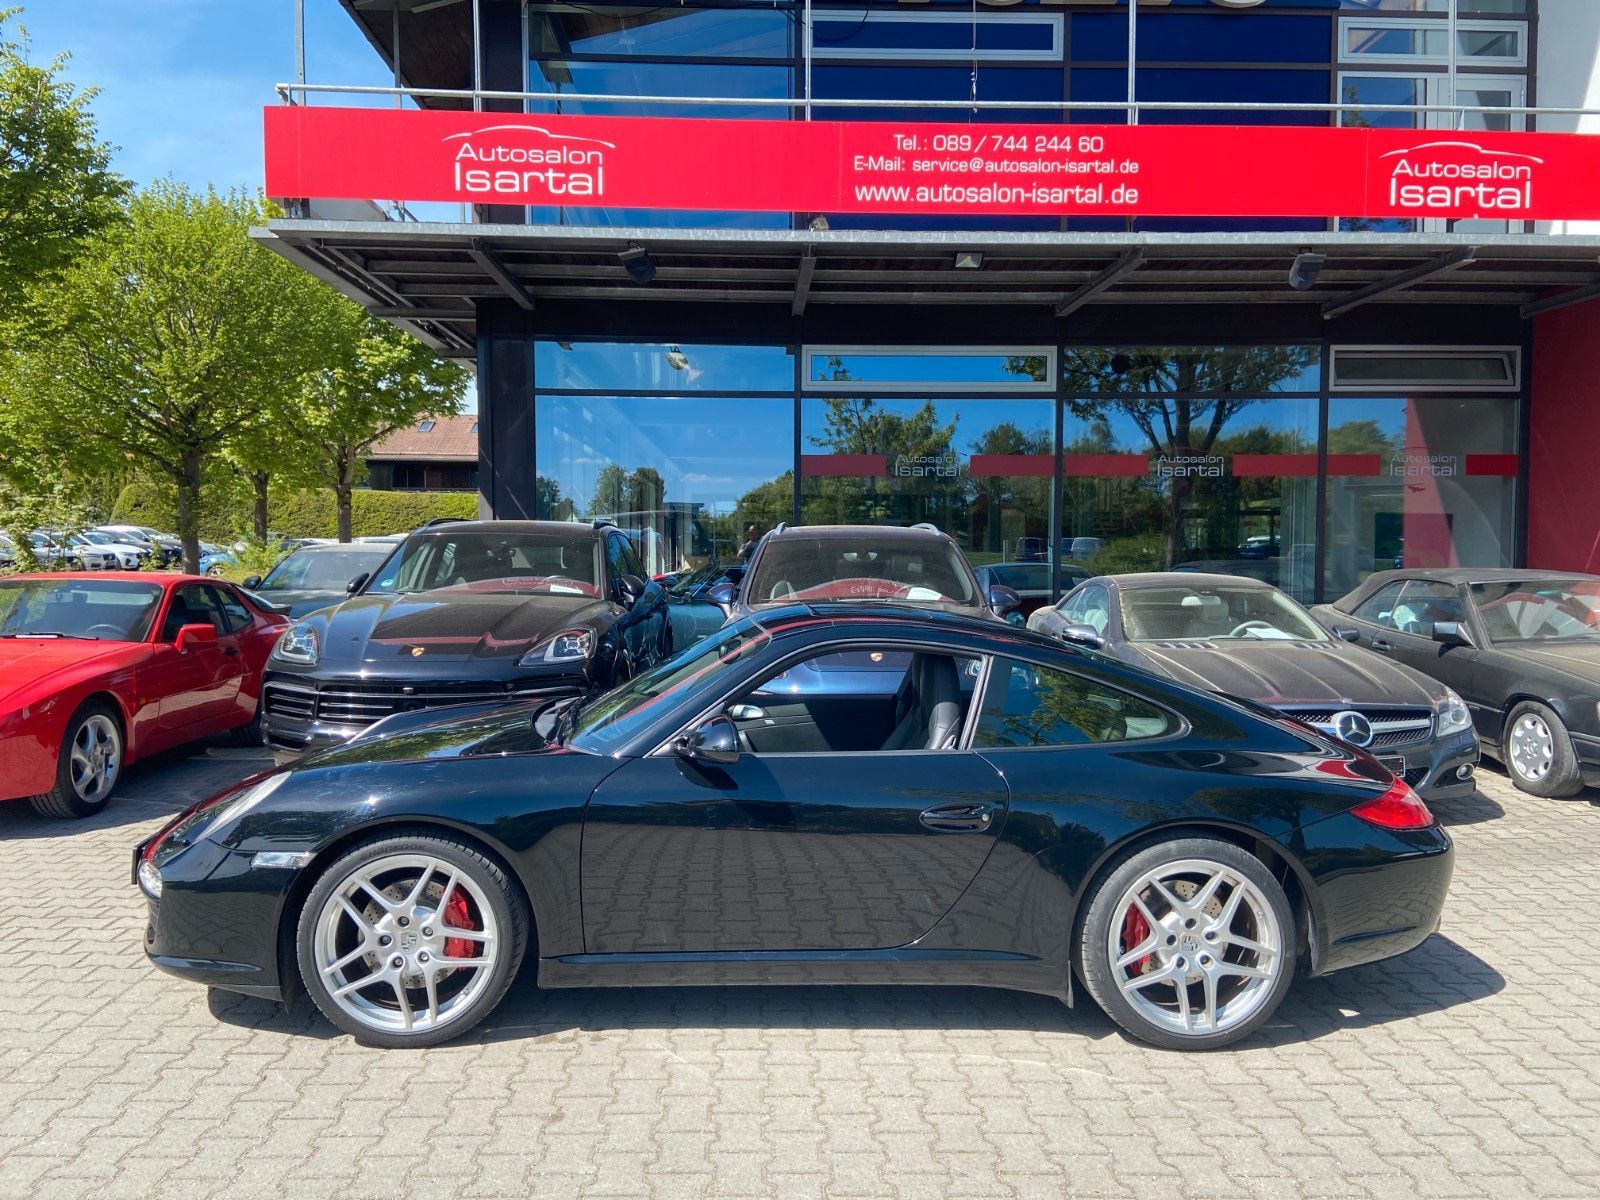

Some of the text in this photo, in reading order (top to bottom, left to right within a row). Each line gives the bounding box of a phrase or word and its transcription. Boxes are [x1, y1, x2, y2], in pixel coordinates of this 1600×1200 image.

[893, 134, 928, 151] Tel.:
[932, 134, 972, 152] 089
[991, 135, 1028, 152] 744
[1034, 135, 1072, 153] 244
[1078, 135, 1104, 153] 60
[455, 142, 603, 165] Autosalon
[853, 155, 1139, 174] E-Mail: service@autosalon-isartal.de
[1391, 158, 1531, 180] Autosalon
[455, 162, 603, 195] Isartal
[854, 182, 1139, 204] www.autosalon-isartal.de
[1389, 177, 1531, 209] Isartal
[1158, 454, 1224, 464] Autosalon
[1391, 454, 1457, 463] Autosalon
[895, 463, 962, 477] Isartal
[1157, 463, 1225, 477] Isartal
[1390, 462, 1457, 477] Isartal
